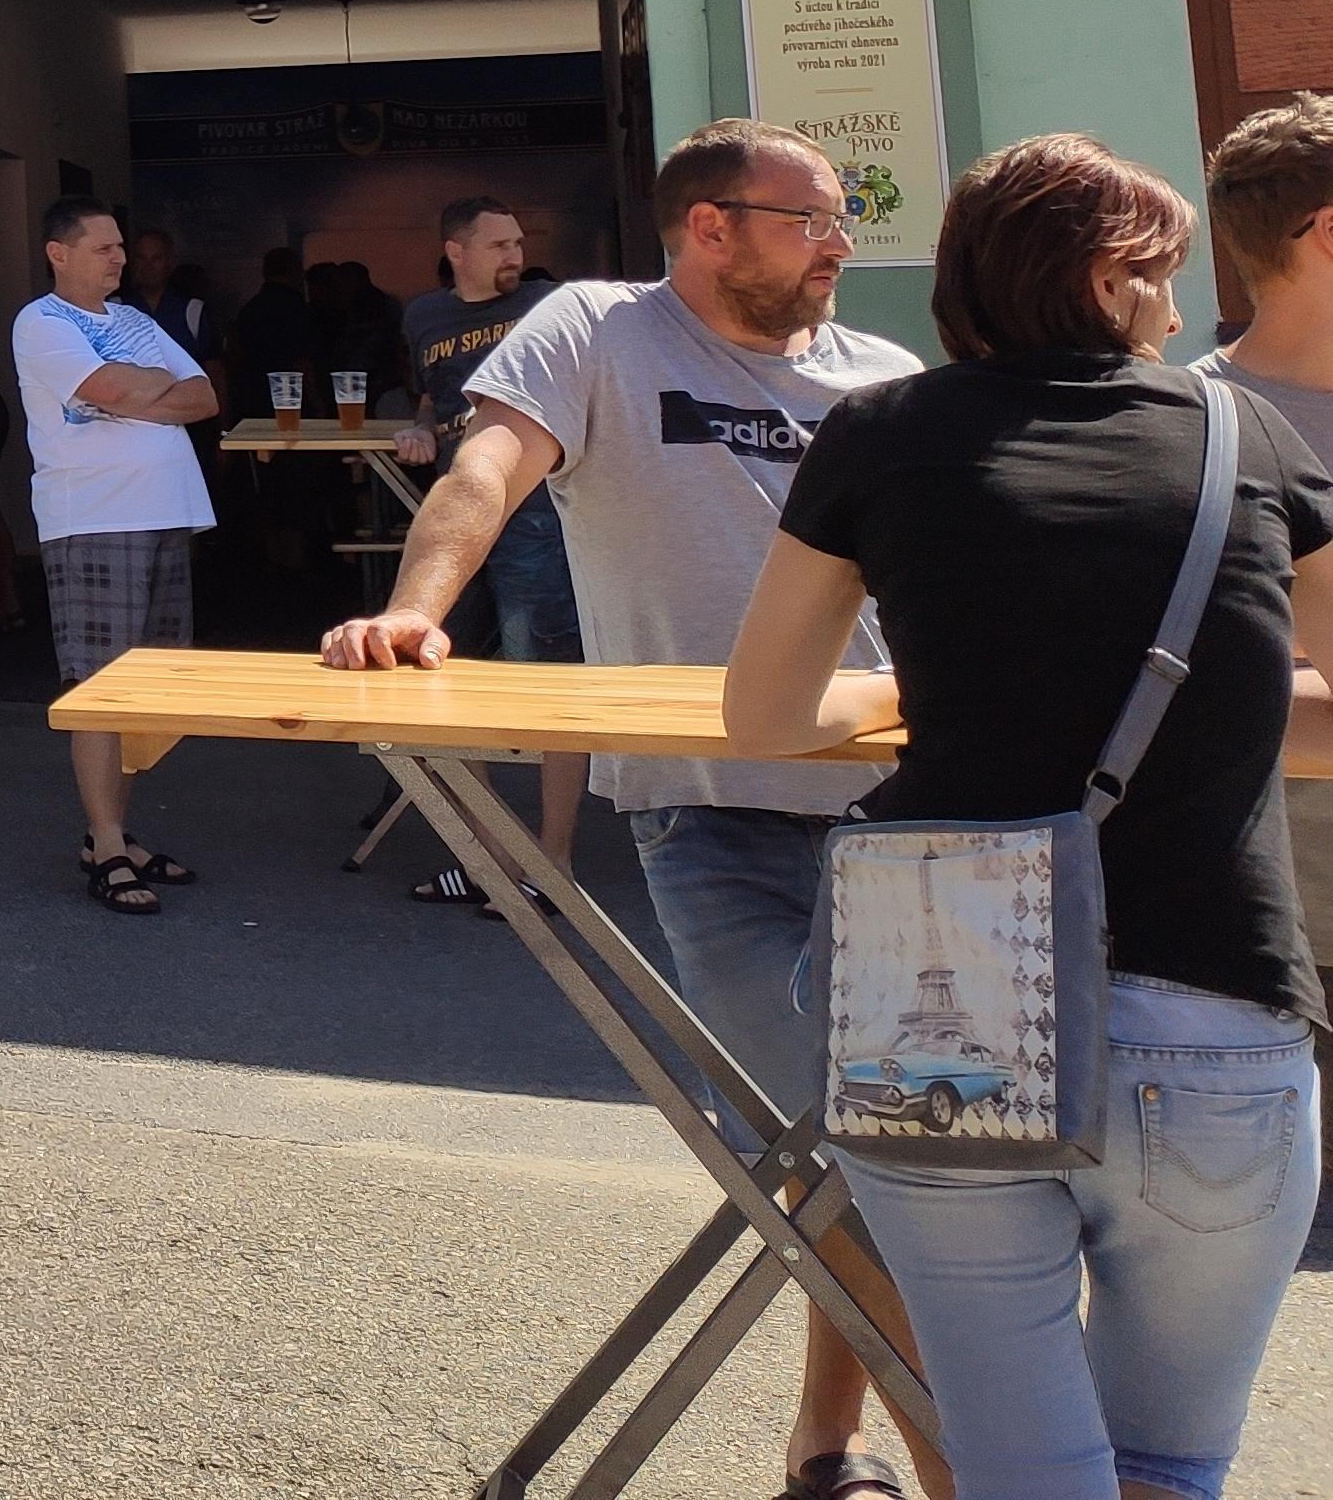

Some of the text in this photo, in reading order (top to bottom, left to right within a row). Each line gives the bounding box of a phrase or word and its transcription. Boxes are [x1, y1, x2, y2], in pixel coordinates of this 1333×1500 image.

[795, 0, 801, 13] S
[837, 0, 842, 11] k
[797, 54, 885, 72] výroba roku 2021
[198, 122, 267, 138] PIVOVAR
[846, 134, 893, 157] PIVO
